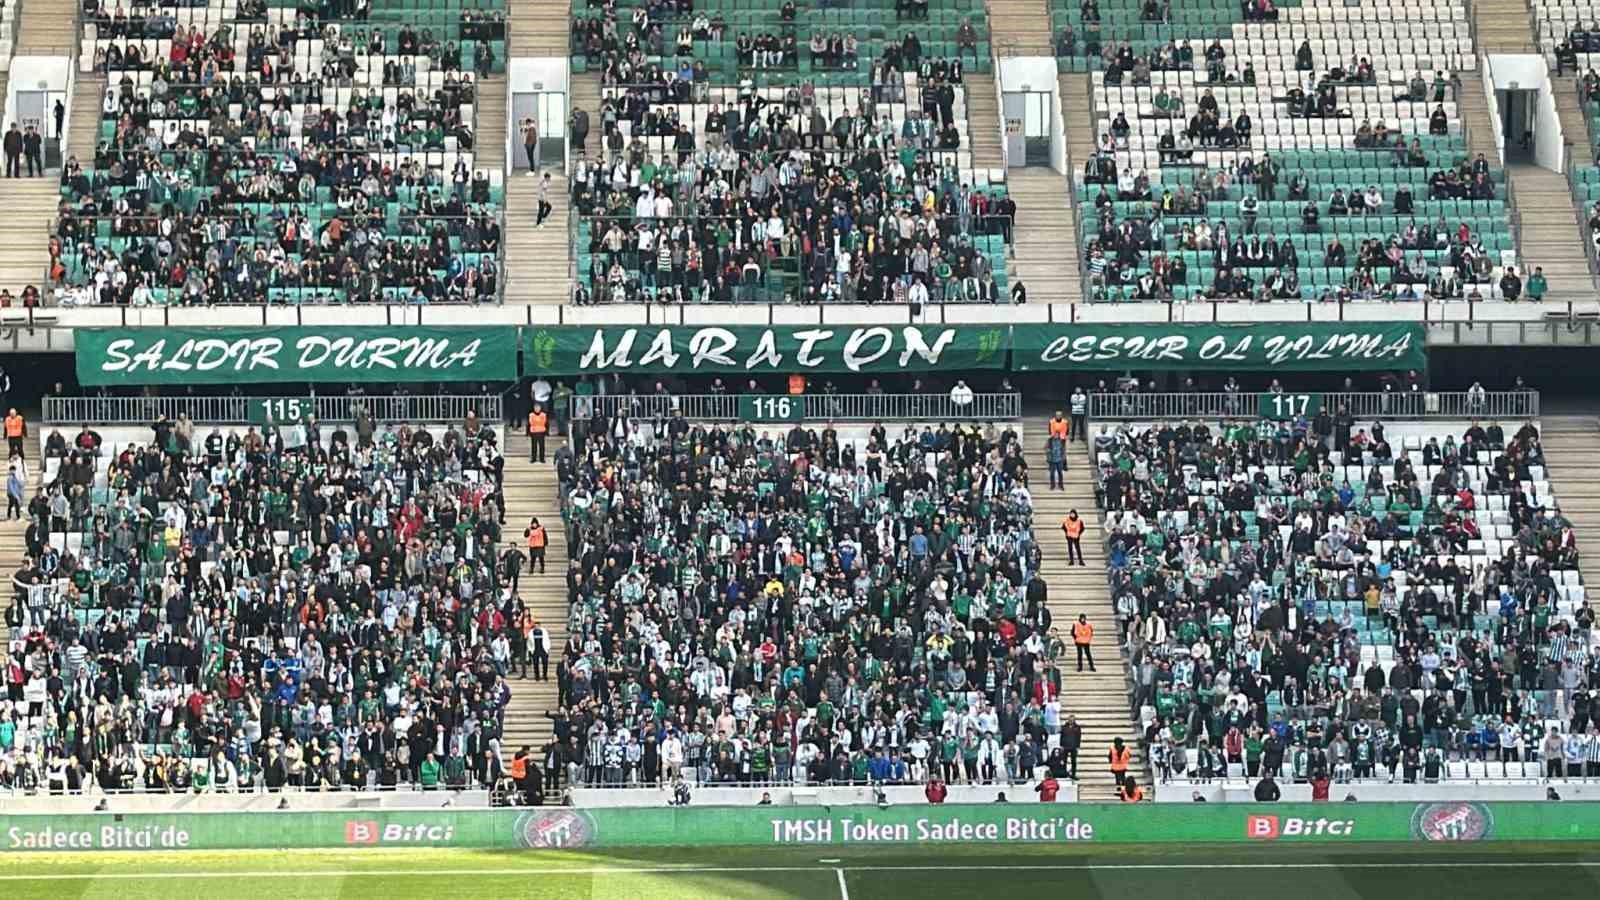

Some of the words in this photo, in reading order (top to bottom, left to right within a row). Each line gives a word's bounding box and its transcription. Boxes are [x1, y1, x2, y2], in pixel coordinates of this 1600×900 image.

[101, 337, 281, 370] SALDIR
[298, 335, 481, 368] DURMA
[579, 326, 956, 371] MARATON
[1040, 335, 1187, 363] CESUR
[1199, 336, 1250, 361] OL
[1264, 331, 1412, 364] YILMA
[261, 399, 300, 420] 115
[752, 397, 790, 419] 116
[1272, 395, 1310, 416] 117
[8, 826, 92, 849] Sadece
[101, 824, 190, 848] Bitci'de
[382, 822, 453, 842] Bitci
[772, 819, 833, 842] TMSH
[841, 819, 909, 841] Token
[916, 818, 999, 841] Sadece
[1006, 817, 1093, 841] Bitci'de
[1283, 817, 1354, 836] Bitci
